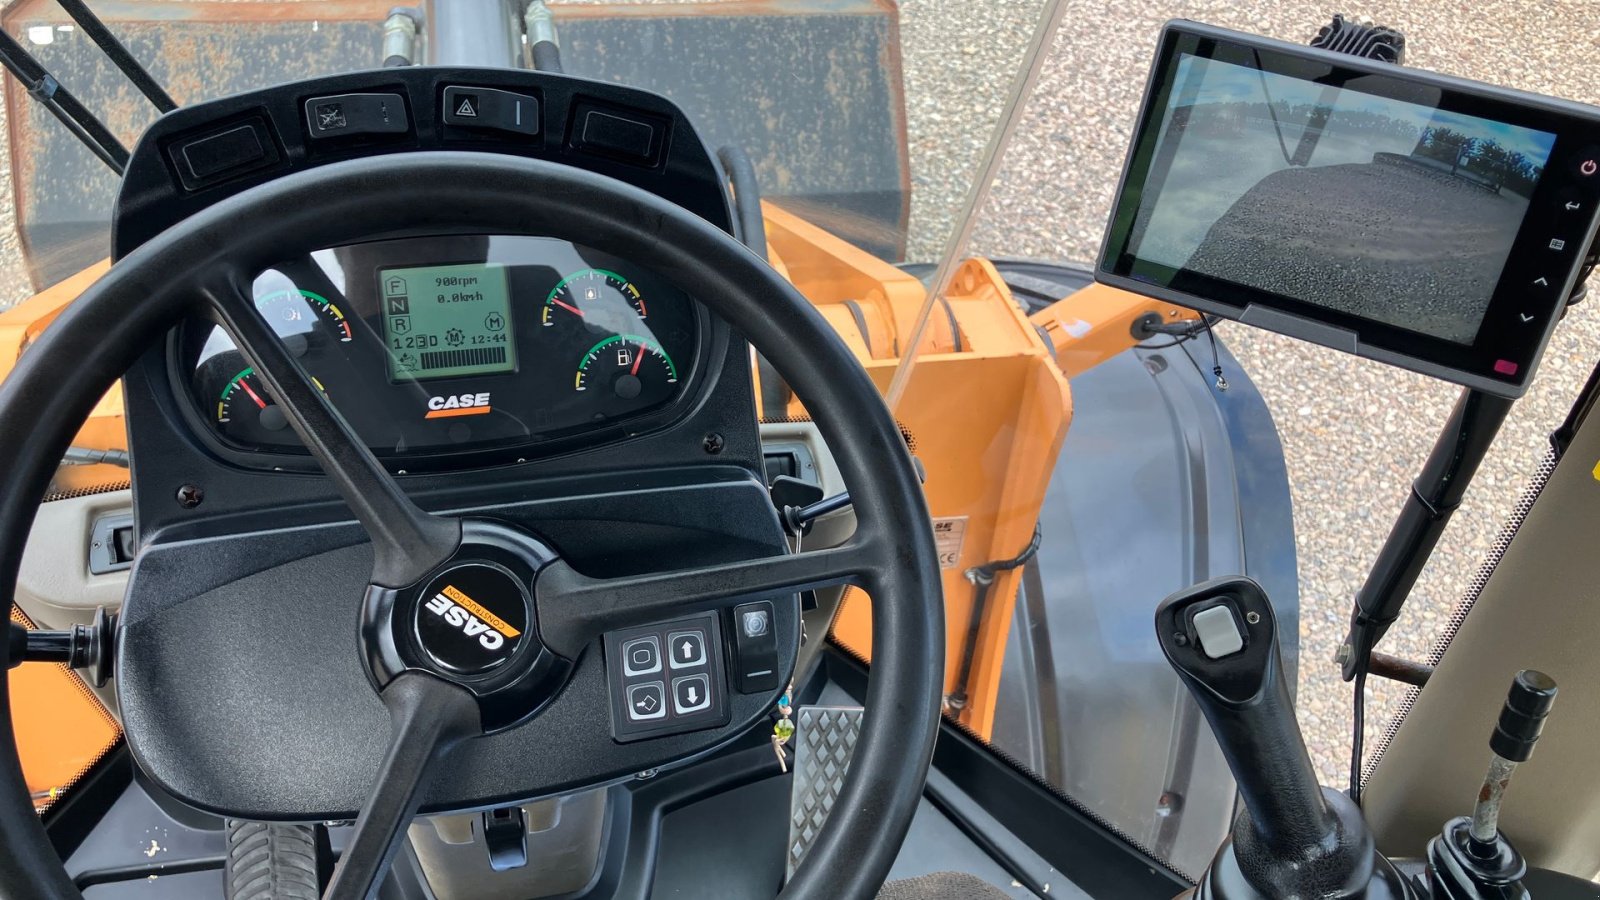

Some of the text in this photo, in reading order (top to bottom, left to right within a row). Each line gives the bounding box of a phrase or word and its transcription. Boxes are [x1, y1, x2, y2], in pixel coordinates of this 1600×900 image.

[390, 280, 401, 294] F
[435, 276, 478, 288] 900rpm
[391, 300, 405, 313] N
[394, 318, 407, 332] R
[470, 333, 507, 345] 12:44
[428, 392, 490, 411] CASE
[447, 587, 505, 631] CONSTRUCTION
[424, 592, 504, 650] CASE
